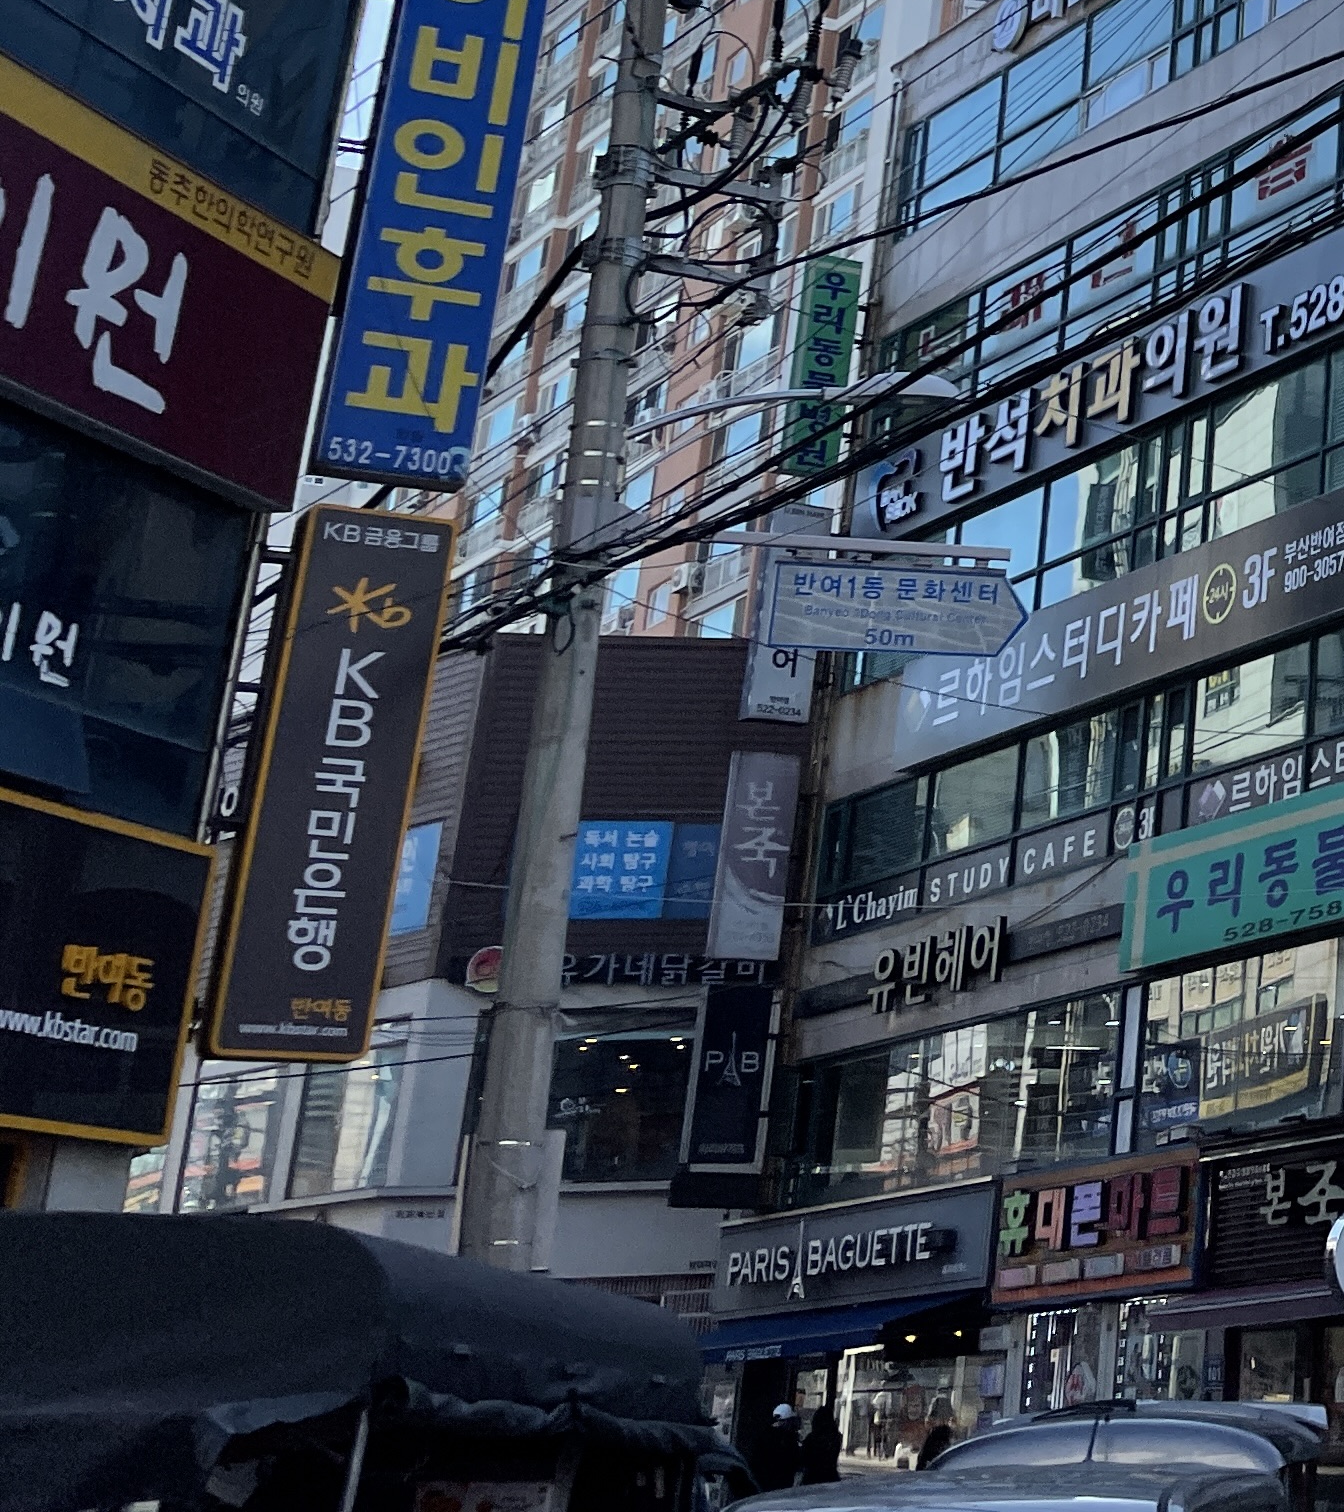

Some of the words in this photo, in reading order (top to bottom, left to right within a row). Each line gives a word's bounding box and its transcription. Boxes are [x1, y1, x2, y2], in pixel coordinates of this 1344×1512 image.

[235, 82, 265, 116] 의원
[326, 435, 453, 478] 532-7300
[323, 520, 361, 544] KB
[362, 526, 440, 554] 금융그룹
[793, 572, 885, 601] 반여1동
[896, 578, 998, 605] 문화센터
[863, 628, 915, 647] 50m
[931, 572, 1200, 727] 르하임스터디카페
[1241, 546, 1279, 610] 3F
[732, 779, 791, 880] 본죽
[929, 855, 1011, 904] STUDY
[1022, 828, 1098, 876] CAFE
[61, 943, 156, 1013] 반여동
[866, 915, 1009, 1016] 유빈헤어
[726, 1249, 791, 1288] PARIS
[805, 1221, 935, 1277] BAGUETTE
